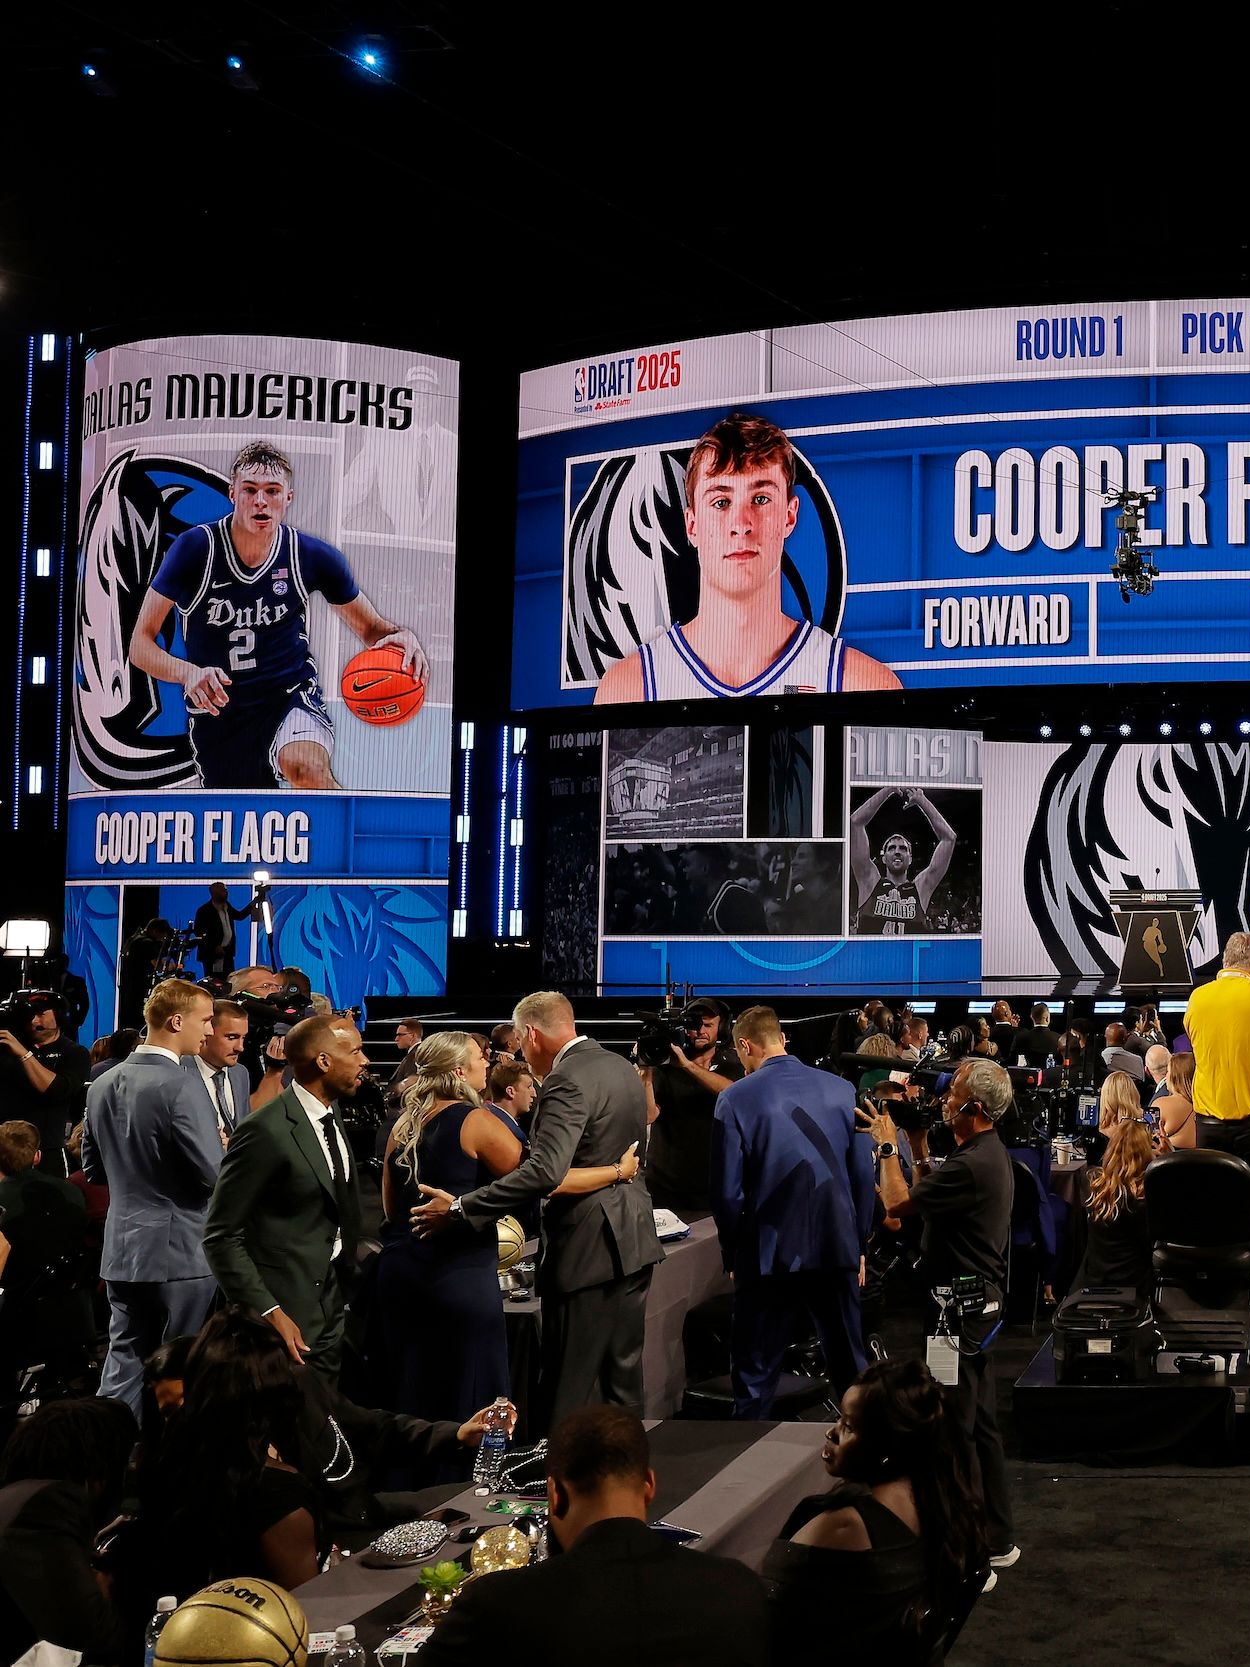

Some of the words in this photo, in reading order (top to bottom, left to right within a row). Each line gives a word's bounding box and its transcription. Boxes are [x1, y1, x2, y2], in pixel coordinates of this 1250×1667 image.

[1016, 316, 1106, 361] ROUND
[1111, 314, 1123, 356] 1
[1182, 313, 1243, 354] PICK
[588, 357, 635, 401] DRAFT
[637, 350, 681, 392] 2025
[83, 377, 152, 441] DALLAS
[165, 372, 414, 431] MAVERICKS
[953, 443, 1208, 555] COOPER
[206, 597, 289, 628] Duke
[924, 593, 1072, 650] FORWARD
[228, 628, 257, 671] 2
[95, 810, 194, 865] COOPER
[203, 810, 310, 864] FLAGG
[874, 899, 916, 919] DALLAS
